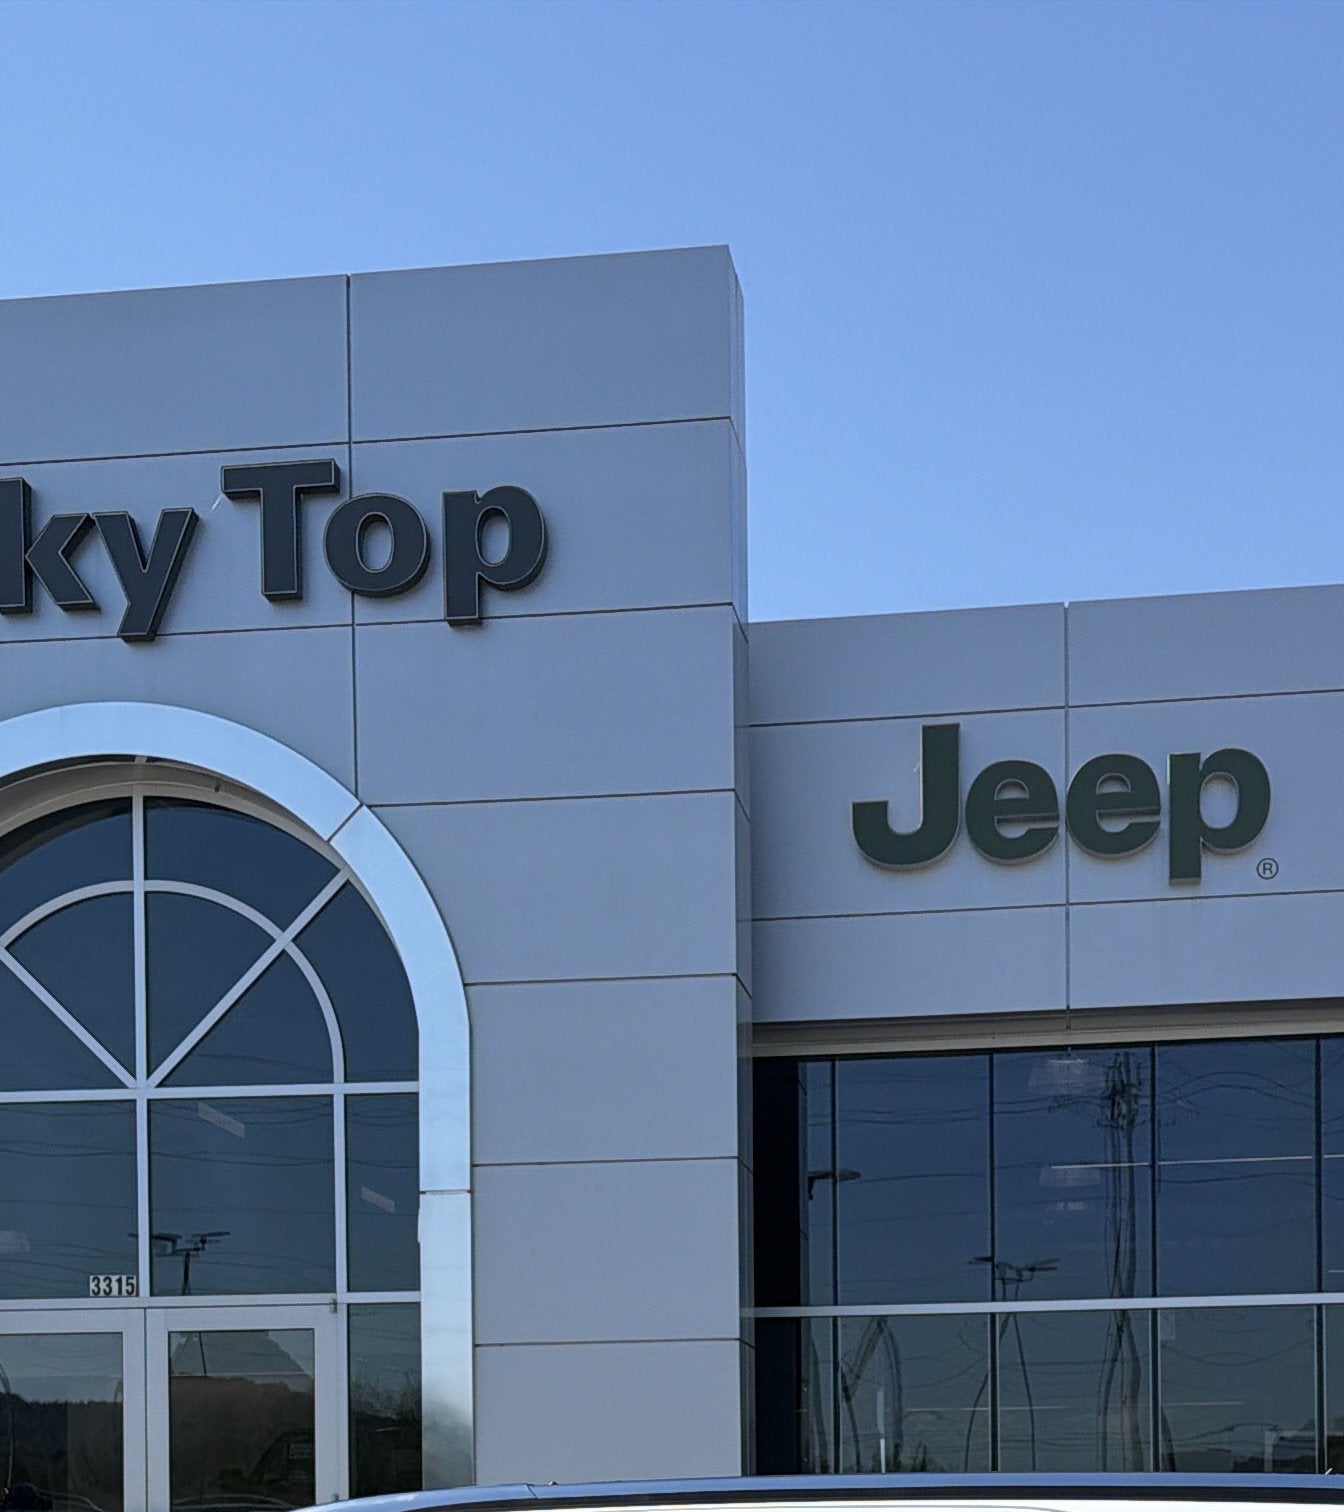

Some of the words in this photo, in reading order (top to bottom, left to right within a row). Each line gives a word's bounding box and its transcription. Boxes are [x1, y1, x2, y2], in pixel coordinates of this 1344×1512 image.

[220, 458, 549, 627] Top
[851, 721, 1272, 886] Jeep
[91, 1276, 135, 1296] 3315
